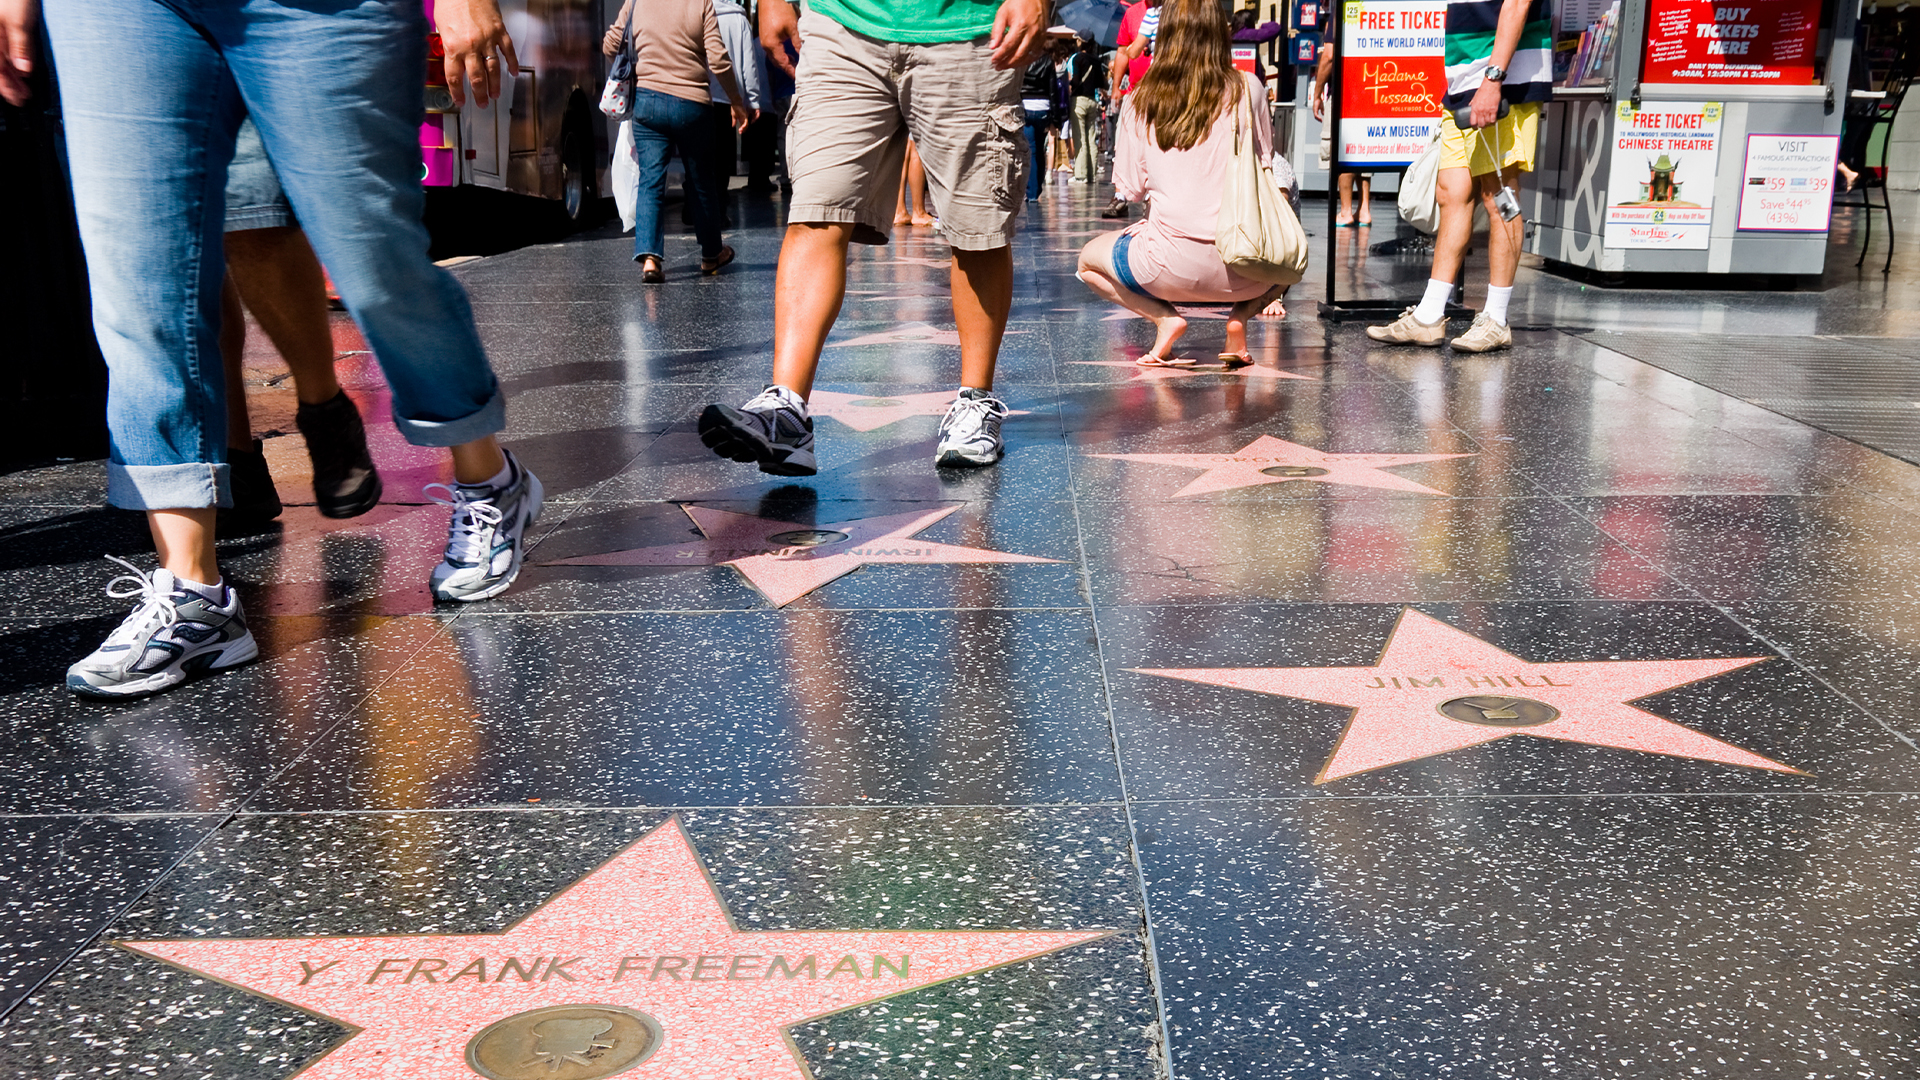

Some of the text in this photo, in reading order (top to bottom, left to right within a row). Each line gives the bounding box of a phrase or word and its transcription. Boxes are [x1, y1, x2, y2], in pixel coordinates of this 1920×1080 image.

[1360, 12, 1395, 29] FREE
[1714, 8, 1751, 21] BUY
[1696, 24, 1759, 38] TICKETS
[1357, 37, 1445, 48] TO THE WORLD FAMOU
[1707, 41, 1750, 54] HERE
[1363, 60, 1428, 84] Madame
[1672, 70, 1704, 78] 9:30AM,
[1365, 82, 1436, 112] Tussauds
[1633, 113, 1704, 128] FREE TICKET
[1367, 126, 1429, 137] WAX MUSEUM
[1346, 143, 1356, 154] With
[1366, 144, 1388, 156] purchase
[1390, 143, 1395, 154] of
[1396, 143, 1410, 154] Movie
[1618, 139, 1714, 150] CHINESE THEATRE
[1778, 141, 1808, 152] VISIT
[1767, 177, 1828, 190] $59 $39
[1760, 198, 1784, 210] Save
[1766, 211, 1798, 225] (43%)
[843, 547, 934, 557] IRWIN
[1365, 675, 1572, 688] JIM HILL
[296, 953, 912, 986] Y FRANK FREEMAN
